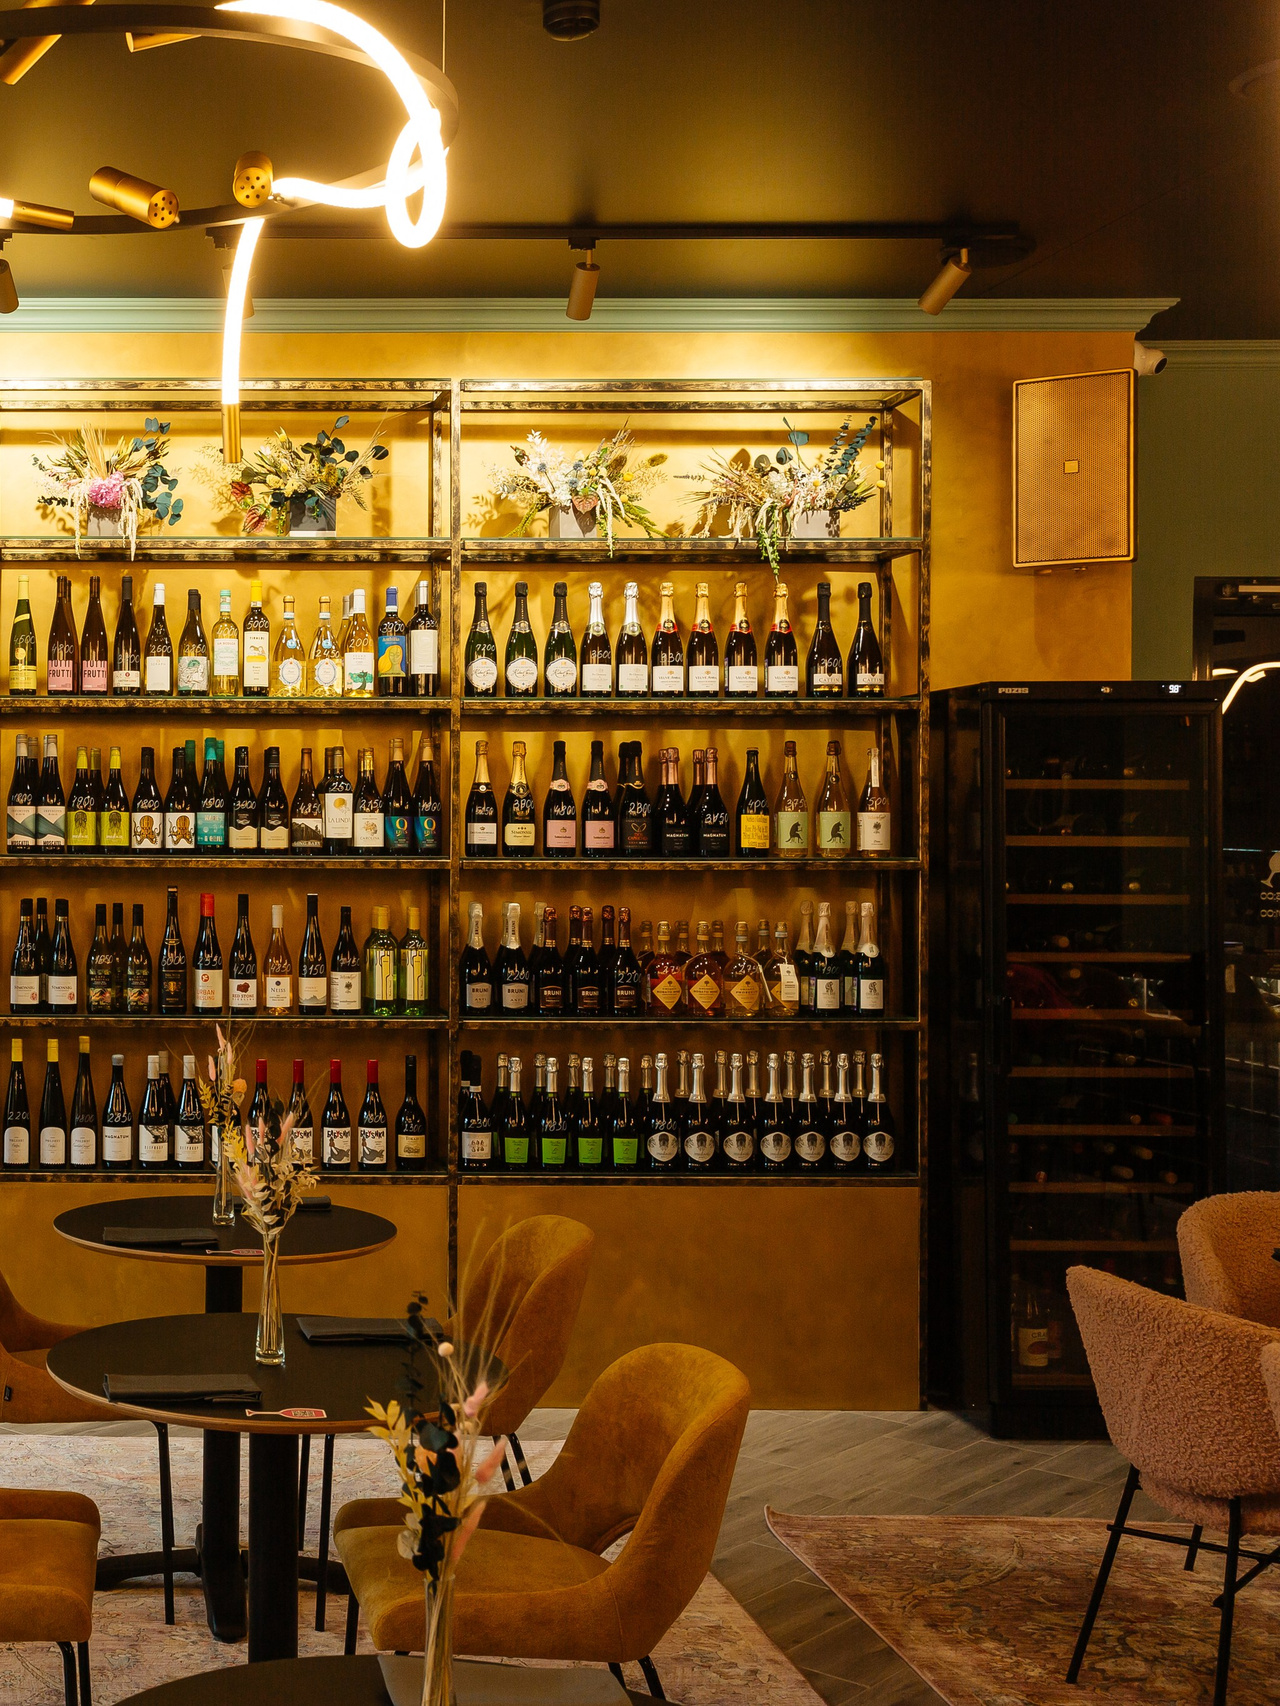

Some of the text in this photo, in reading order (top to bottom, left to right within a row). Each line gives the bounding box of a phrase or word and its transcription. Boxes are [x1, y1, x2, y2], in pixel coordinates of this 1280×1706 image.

[316, 648, 339, 659] 2450
[48, 670, 72, 678] FRUTTI
[83, 670, 107, 678] FRUTTI
